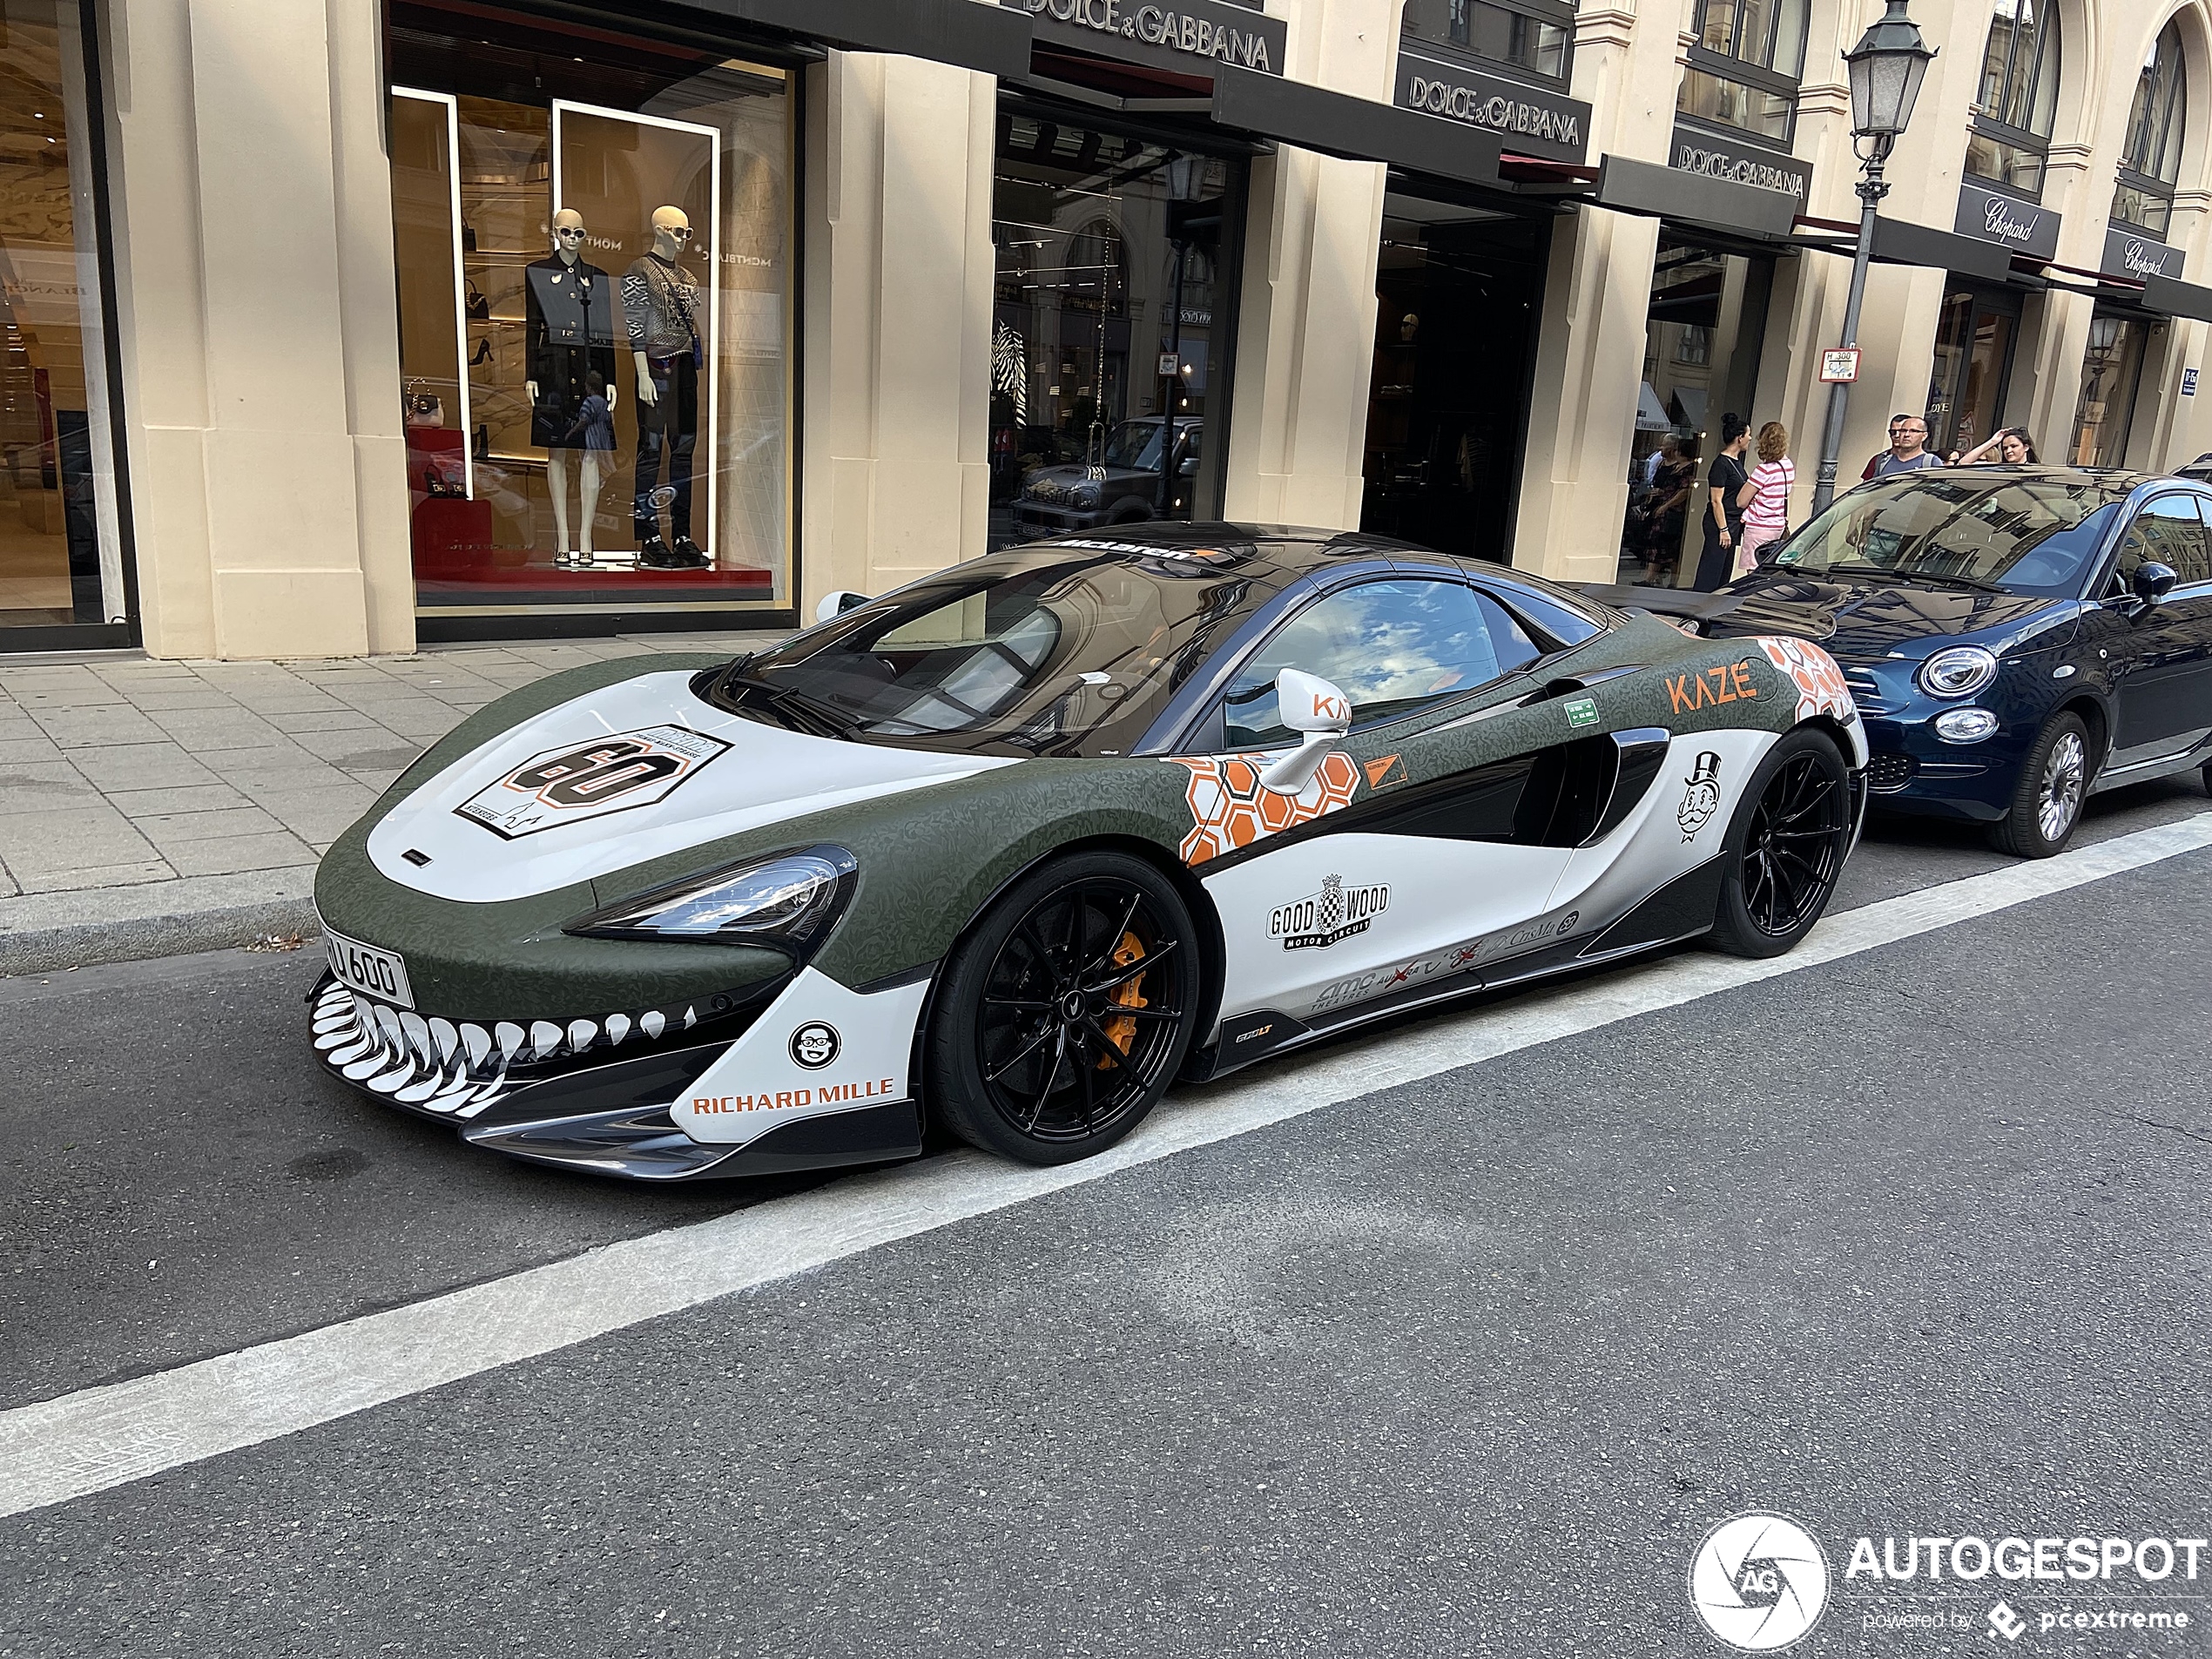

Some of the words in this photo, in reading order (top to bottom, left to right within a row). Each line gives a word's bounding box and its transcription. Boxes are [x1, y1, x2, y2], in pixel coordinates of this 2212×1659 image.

[1409, 76, 1580, 146] DOLCE&GABBANA
[1984, 197, 2040, 243] Chopard
[2124, 239, 2168, 279] Chopard
[1053, 538, 1191, 561] McLaren
[1664, 662, 1757, 715] KAZE
[502, 738, 691, 810] 60
[1286, 937, 1322, 948] MOTOR
[1327, 921, 1370, 944] CIRCUIT
[349, 946, 397, 997] 600
[1311, 988, 1370, 1011] THEATRES
[693, 1088, 812, 1115] RICHARD
[819, 1077, 894, 1104] MILLE
